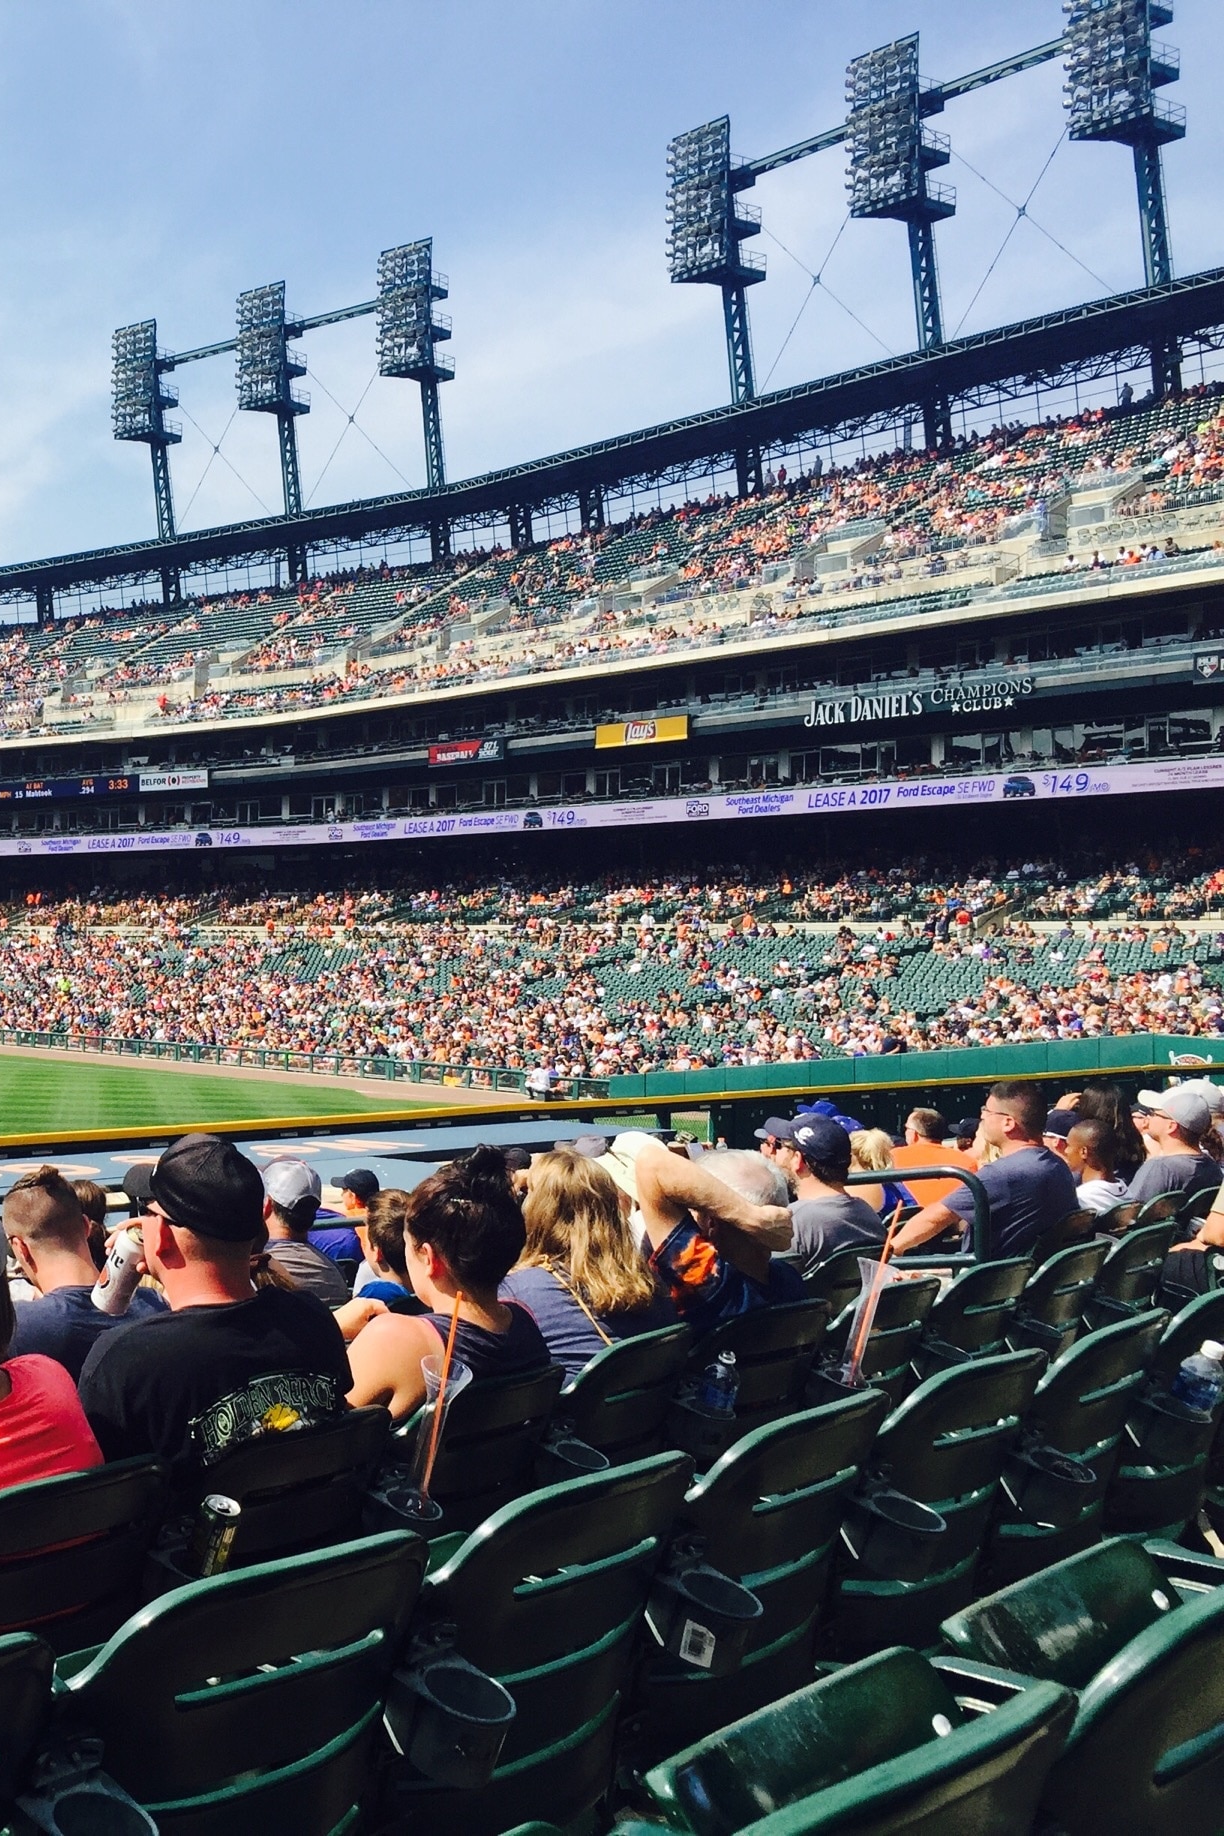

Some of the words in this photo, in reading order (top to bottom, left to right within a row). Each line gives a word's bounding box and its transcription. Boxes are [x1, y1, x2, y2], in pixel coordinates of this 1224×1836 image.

[930, 677, 1033, 704] CHAMPIONS
[803, 699, 845, 728] JACK
[850, 690, 923, 722] DANIEL'S
[962, 697, 1003, 713] CLUB
[626, 720, 655, 742] Lay's
[108, 779, 129, 790] 3:33
[140, 778, 167, 787] BELFOR
[14, 791, 24, 799] 15
[25, 789, 53, 798] Mahtook
[726, 796, 760, 806] Southeast
[762, 794, 794, 805] Michigan
[807, 791, 844, 808] LEASE
[847, 791, 856, 806] A
[860, 788, 891, 804] 2017
[897, 786, 919, 798] Ford
[920, 783, 955, 798] Escape
[956, 782, 970, 794] SE
[971, 780, 995, 793] FWD
[686, 804, 708, 813] FORD
[738, 804, 754, 815] Ford
[754, 803, 781, 814] Dealers
[353, 823, 375, 832] Southeast
[376, 822, 396, 830] Michigan
[403, 822, 427, 835] LEASE
[428, 821, 435, 834] A
[435, 819, 456, 832] 2017
[458, 818, 473, 827] Ford
[473, 816, 495, 827] Escape
[495, 815, 504, 824] SE
[87, 838, 110, 849] LEASE
[110, 838, 116, 848] A
[117, 837, 135, 848] 2017
[137, 836, 151, 844] Ford
[151, 835, 170, 844] Escape
[200, 1382, 276, 1453] HOLDEN
